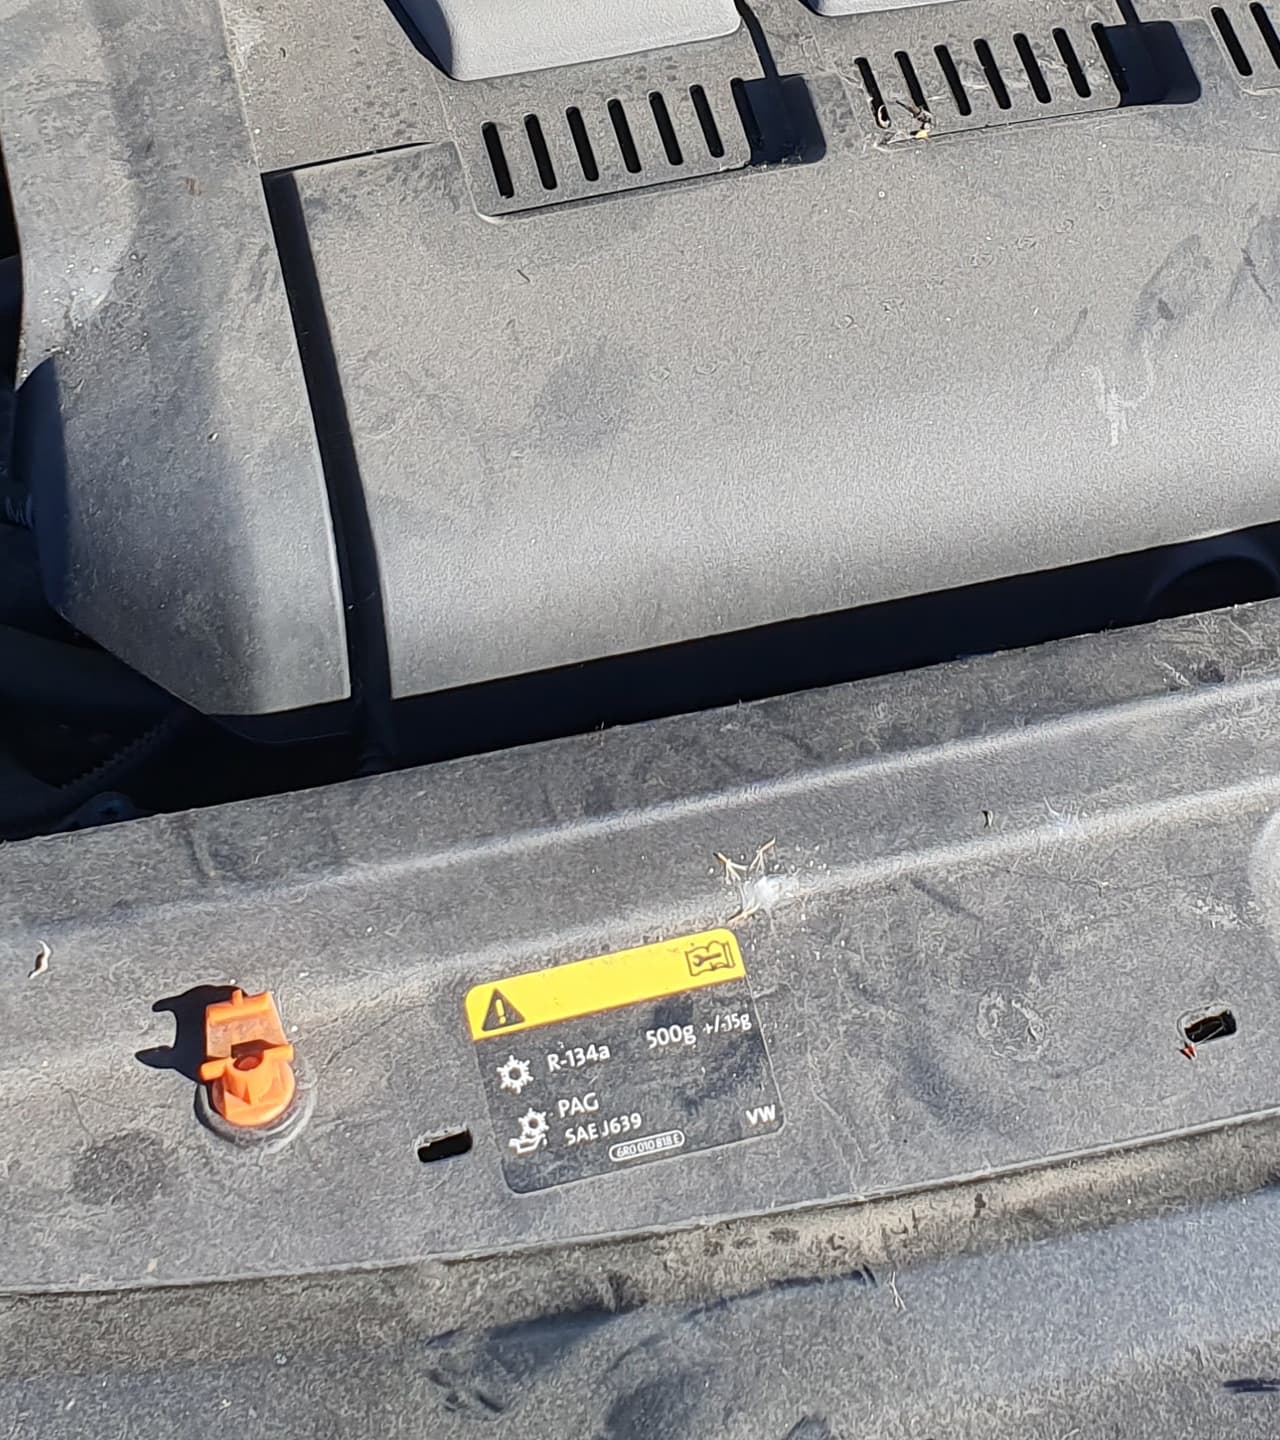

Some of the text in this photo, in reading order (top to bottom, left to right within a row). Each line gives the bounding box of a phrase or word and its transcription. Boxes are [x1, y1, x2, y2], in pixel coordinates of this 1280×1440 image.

[547, 1044, 611, 1074] R-134a
[646, 1022, 697, 1050] 500g
[557, 1092, 600, 1119] PAG
[745, 1103, 778, 1128] VW
[564, 1111, 643, 1147] SAE J639
